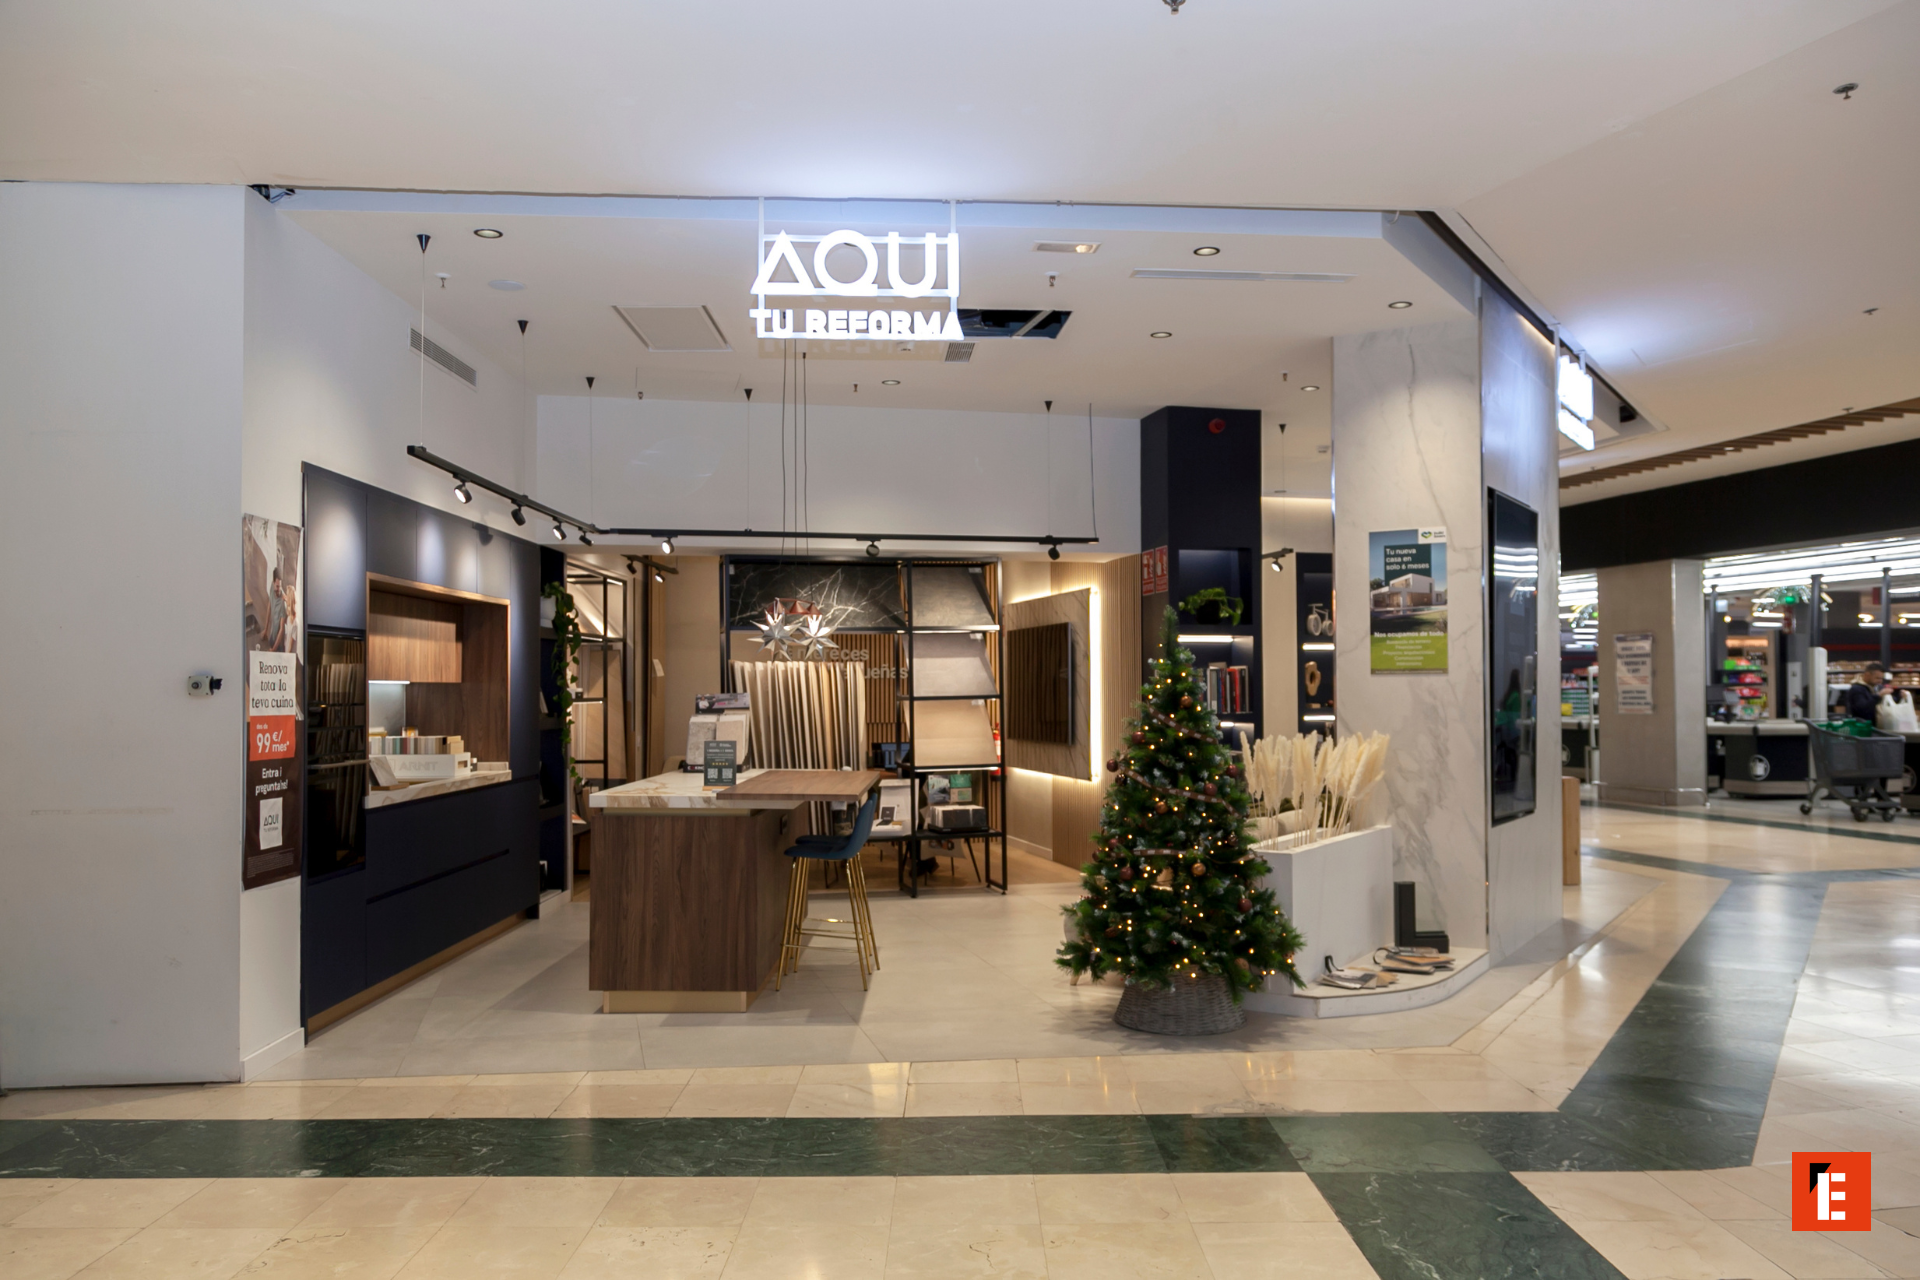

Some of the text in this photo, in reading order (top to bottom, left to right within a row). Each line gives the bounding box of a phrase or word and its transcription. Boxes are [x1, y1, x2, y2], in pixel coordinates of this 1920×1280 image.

[750, 229, 960, 298] AQUI
[749, 308, 965, 340] TU REFORMA
[259, 661, 288, 675] Renova
[260, 678, 287, 691] tota la
[251, 695, 294, 709] teva cuina
[256, 732, 271, 753] 99
[262, 767, 279, 779] Entra
